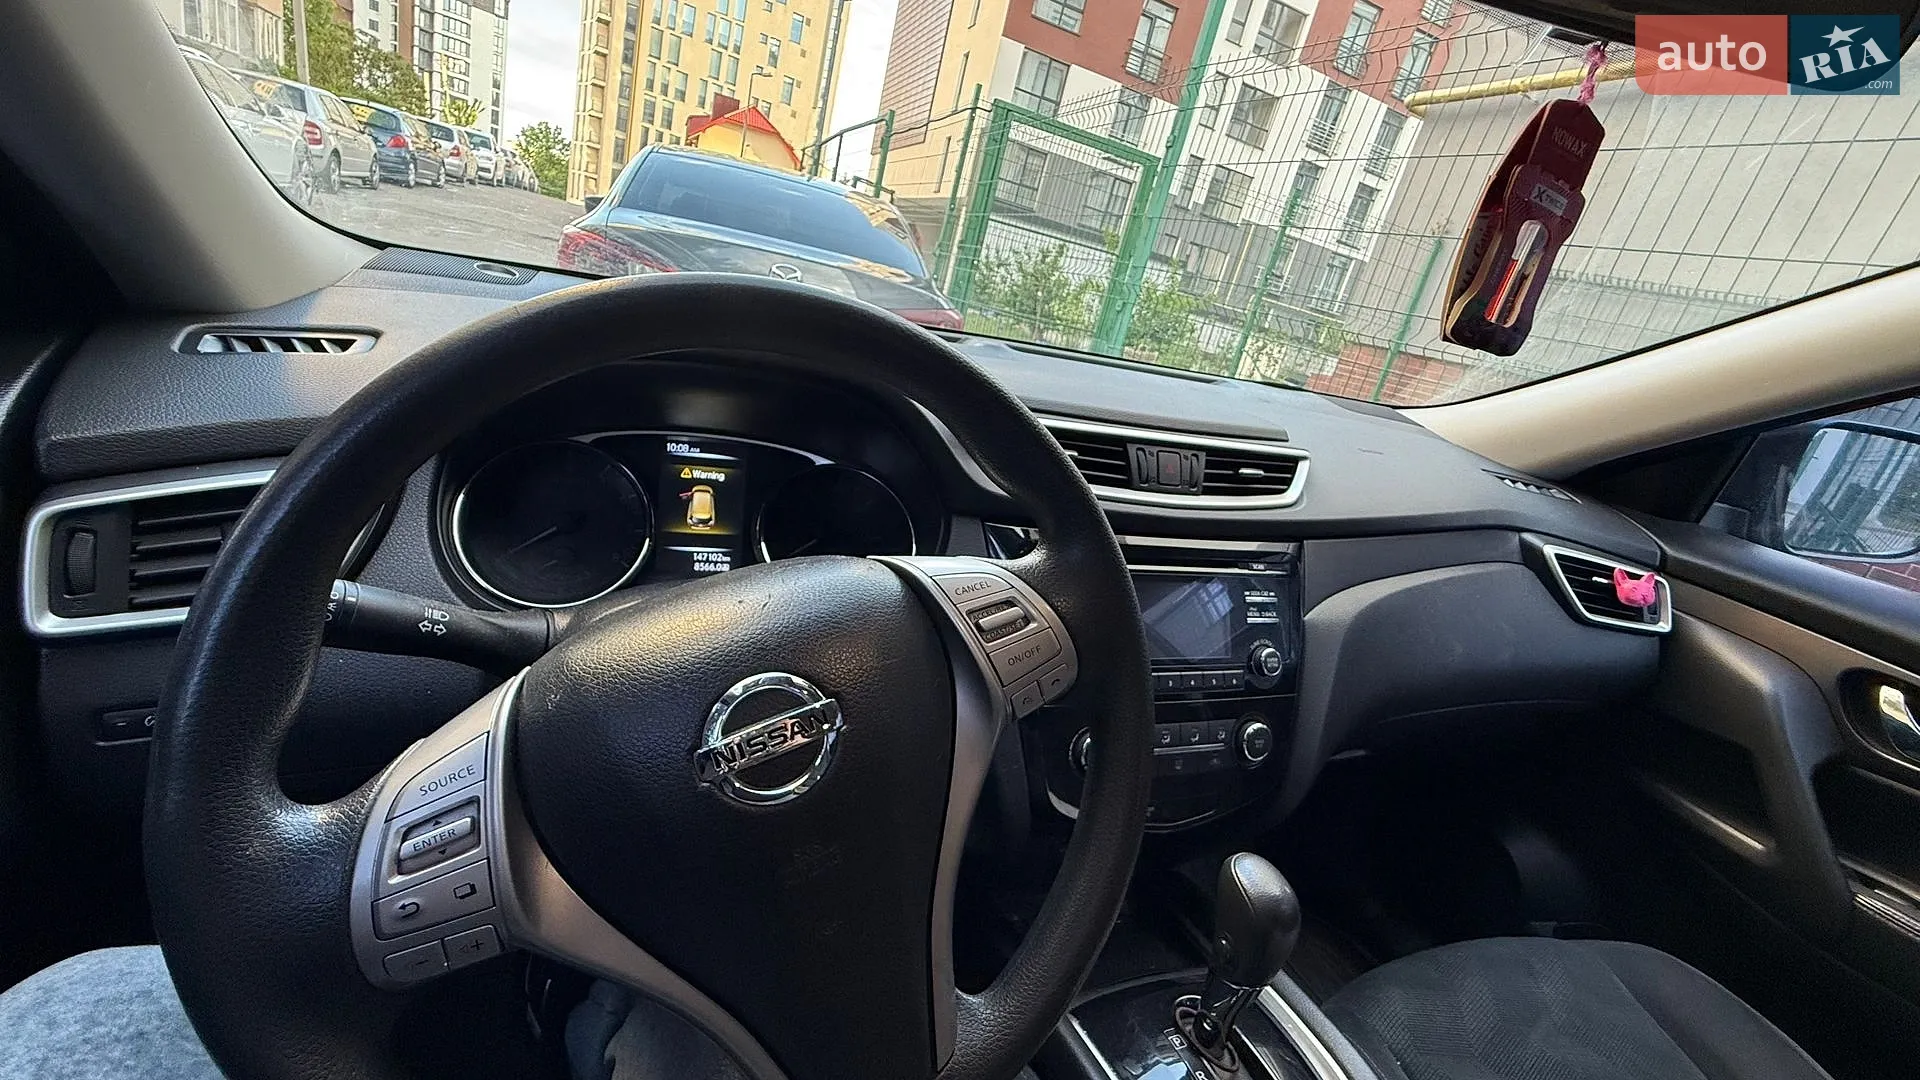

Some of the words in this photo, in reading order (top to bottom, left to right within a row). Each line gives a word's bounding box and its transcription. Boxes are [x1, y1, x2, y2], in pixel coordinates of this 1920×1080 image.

[1551, 126, 1588, 158] NOWAX
[691, 469, 726, 482] Warning
[954, 580, 992, 596] CANCEL
[1007, 645, 1042, 667] ON/OFF
[710, 708, 831, 772] NISSAN
[419, 764, 476, 797] SOURCE
[412, 828, 457, 852] ENTER
[1172, 1037, 1182, 1048] P
